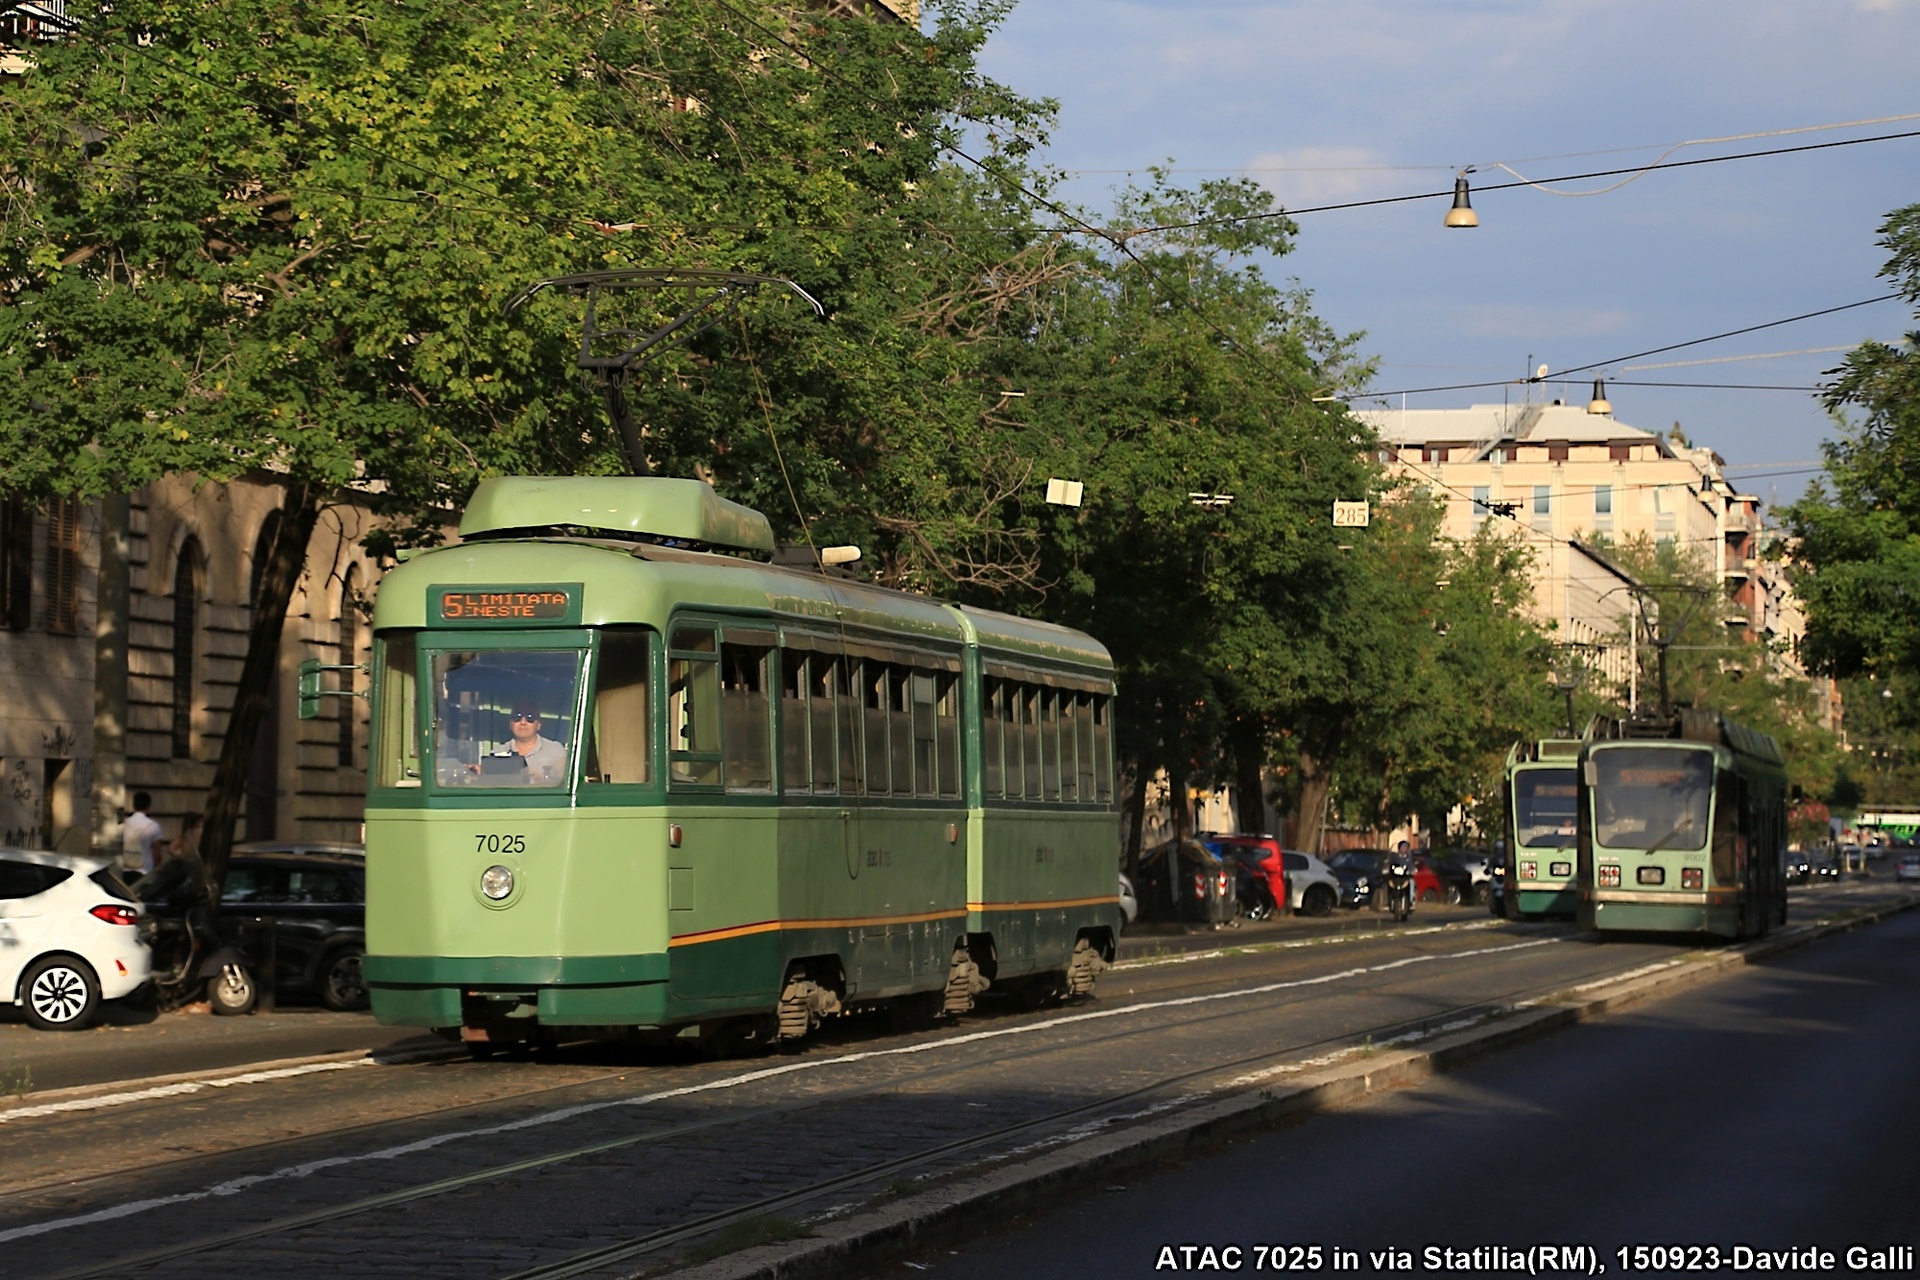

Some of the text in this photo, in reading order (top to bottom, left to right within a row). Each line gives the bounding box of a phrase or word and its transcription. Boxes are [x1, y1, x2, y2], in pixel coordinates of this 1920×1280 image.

[1336, 507, 1366, 525] 285
[444, 594, 565, 617] 5 LIMITATA
[475, 834, 526, 854] 7025
